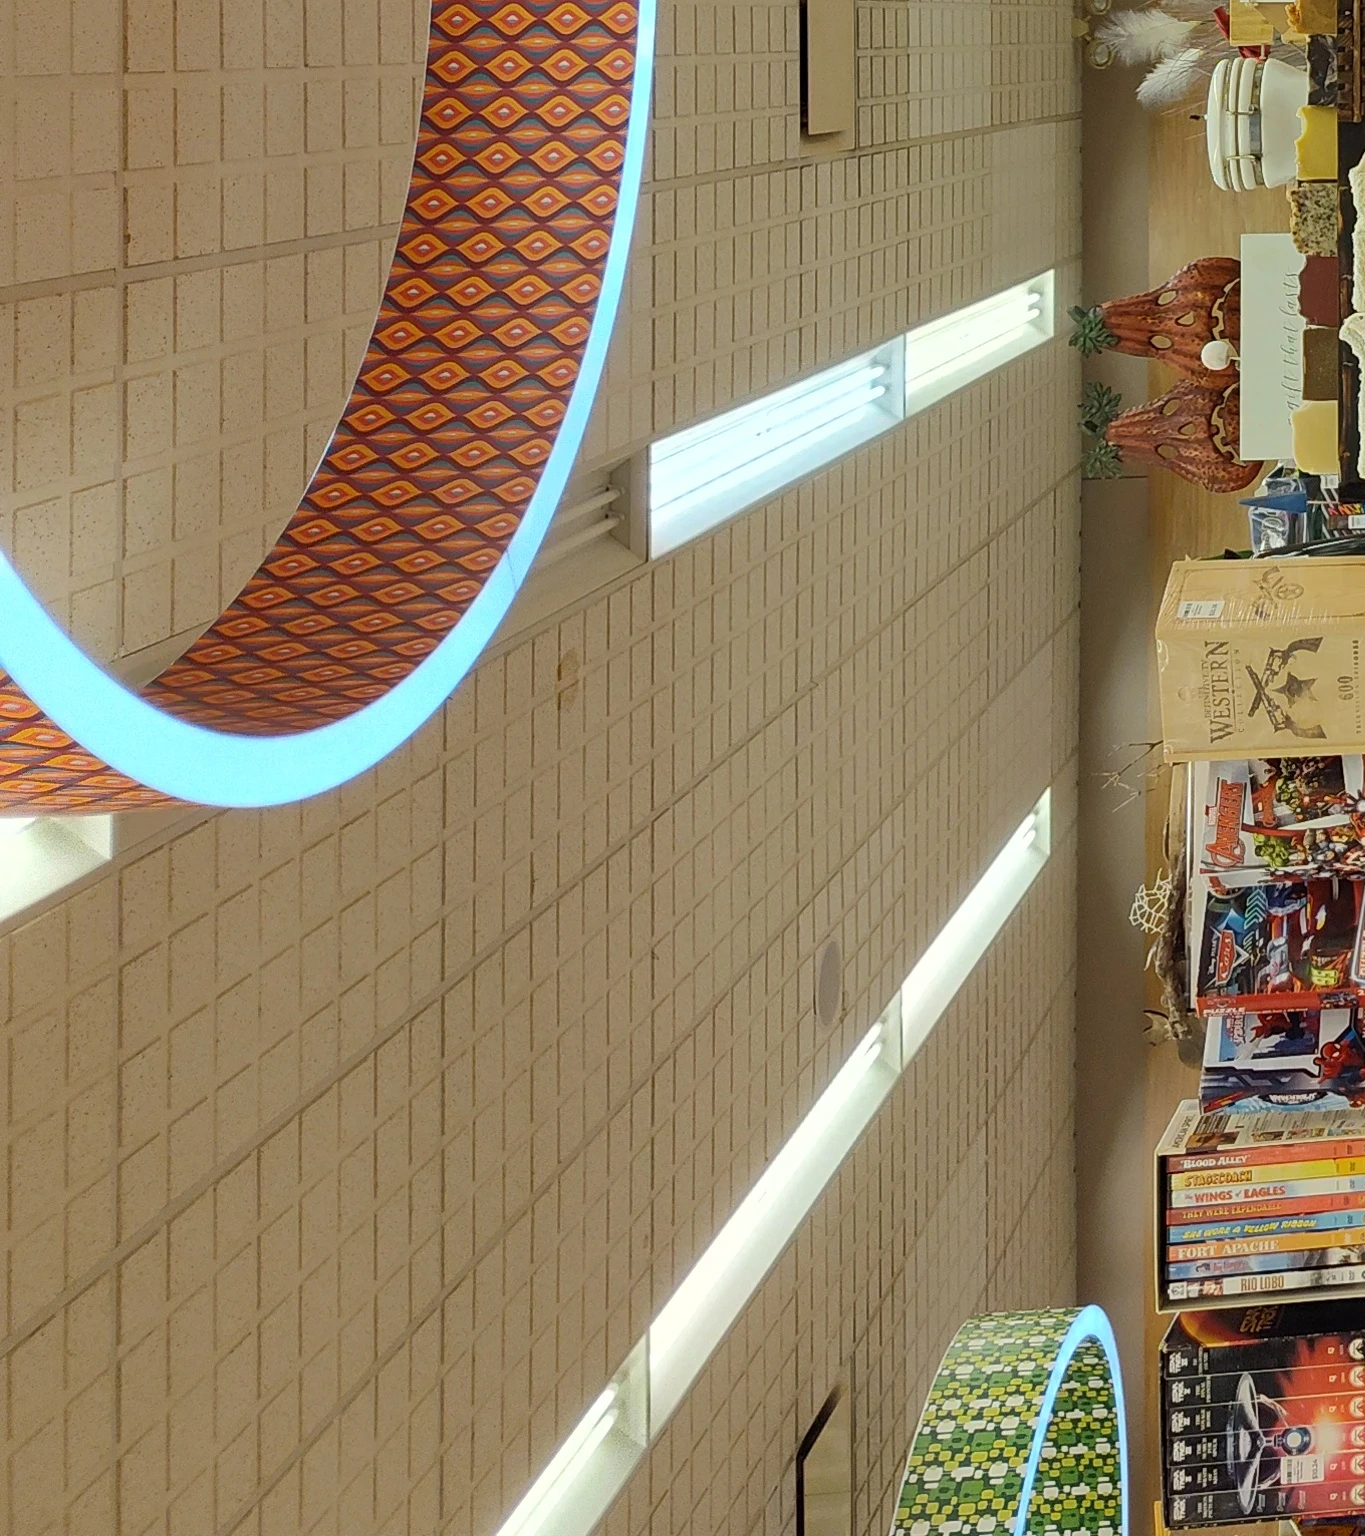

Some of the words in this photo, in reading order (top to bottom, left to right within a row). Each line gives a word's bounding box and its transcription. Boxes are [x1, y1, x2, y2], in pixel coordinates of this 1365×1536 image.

[1278, 264, 1299, 317] lasts
[1280, 318, 1300, 366] that
[1280, 368, 1301, 411] gift
[1204, 641, 1234, 743] WESTERN
[1234, 649, 1244, 733] COLLECTION
[1337, 676, 1353, 700] 600
[1206, 779, 1245, 867] AVENGERS
[1220, 936, 1234, 979] Cars
[1185, 1170, 1252, 1187] STAGECOACH
[1178, 1247, 1217, 1259] FORT
[1222, 1240, 1279, 1255] APACHE
[1241, 1278, 1257, 1292] RIO
[1259, 1275, 1284, 1290] LOBO
